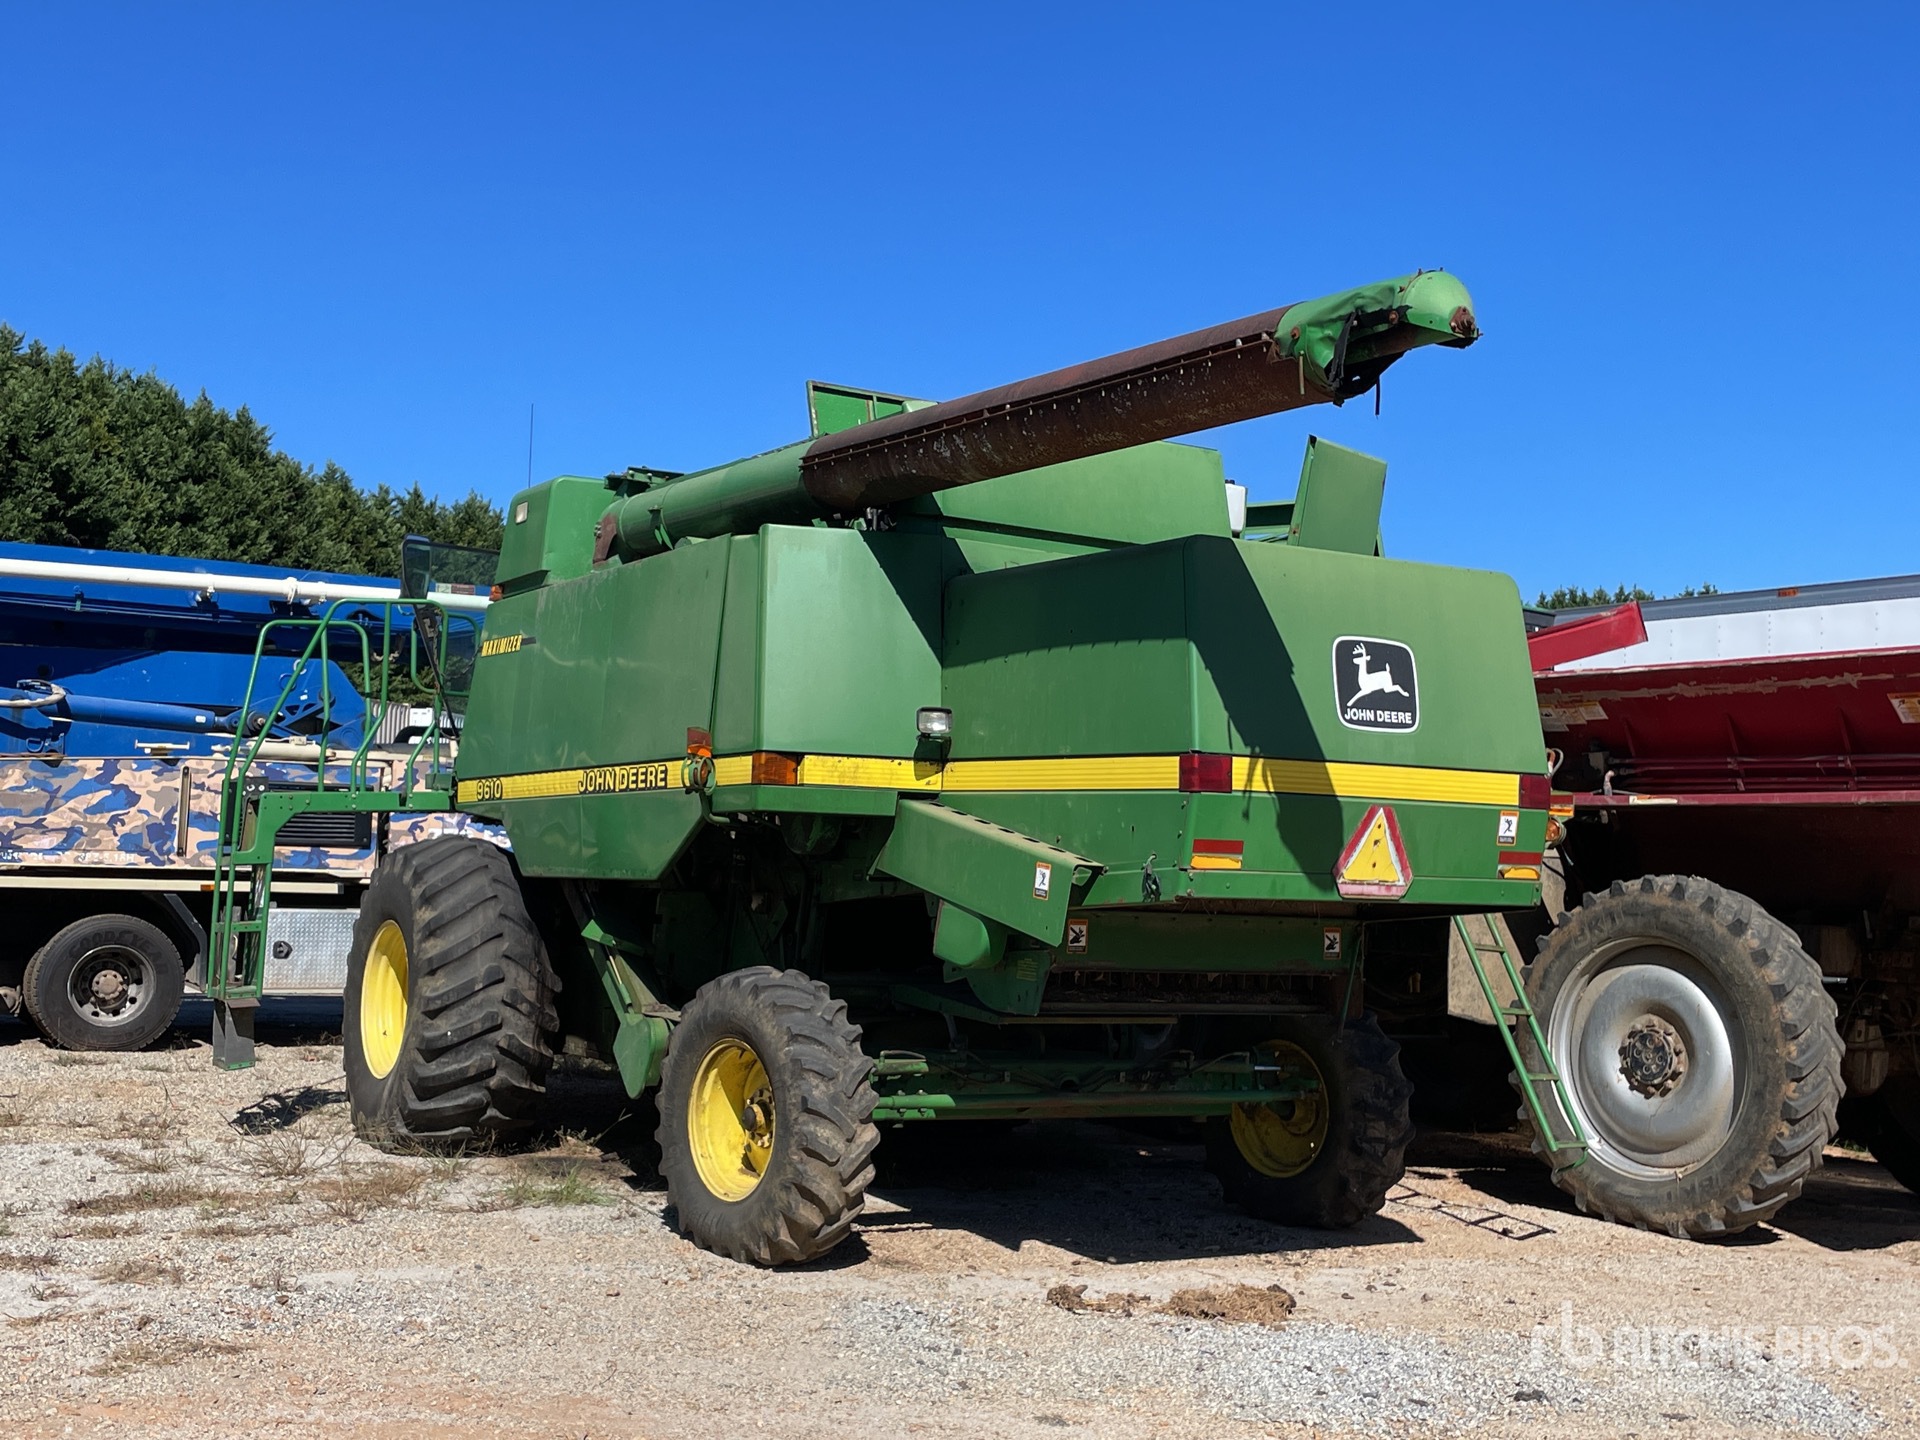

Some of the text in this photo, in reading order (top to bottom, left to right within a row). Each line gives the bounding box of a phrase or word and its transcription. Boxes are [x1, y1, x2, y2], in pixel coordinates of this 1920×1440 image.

[480, 633, 523, 657] MAXIMIZER
[1344, 708, 1412, 724] JOHN DEERE
[477, 778, 502, 801] 9610
[578, 764, 668, 794] JOHN DEERE
